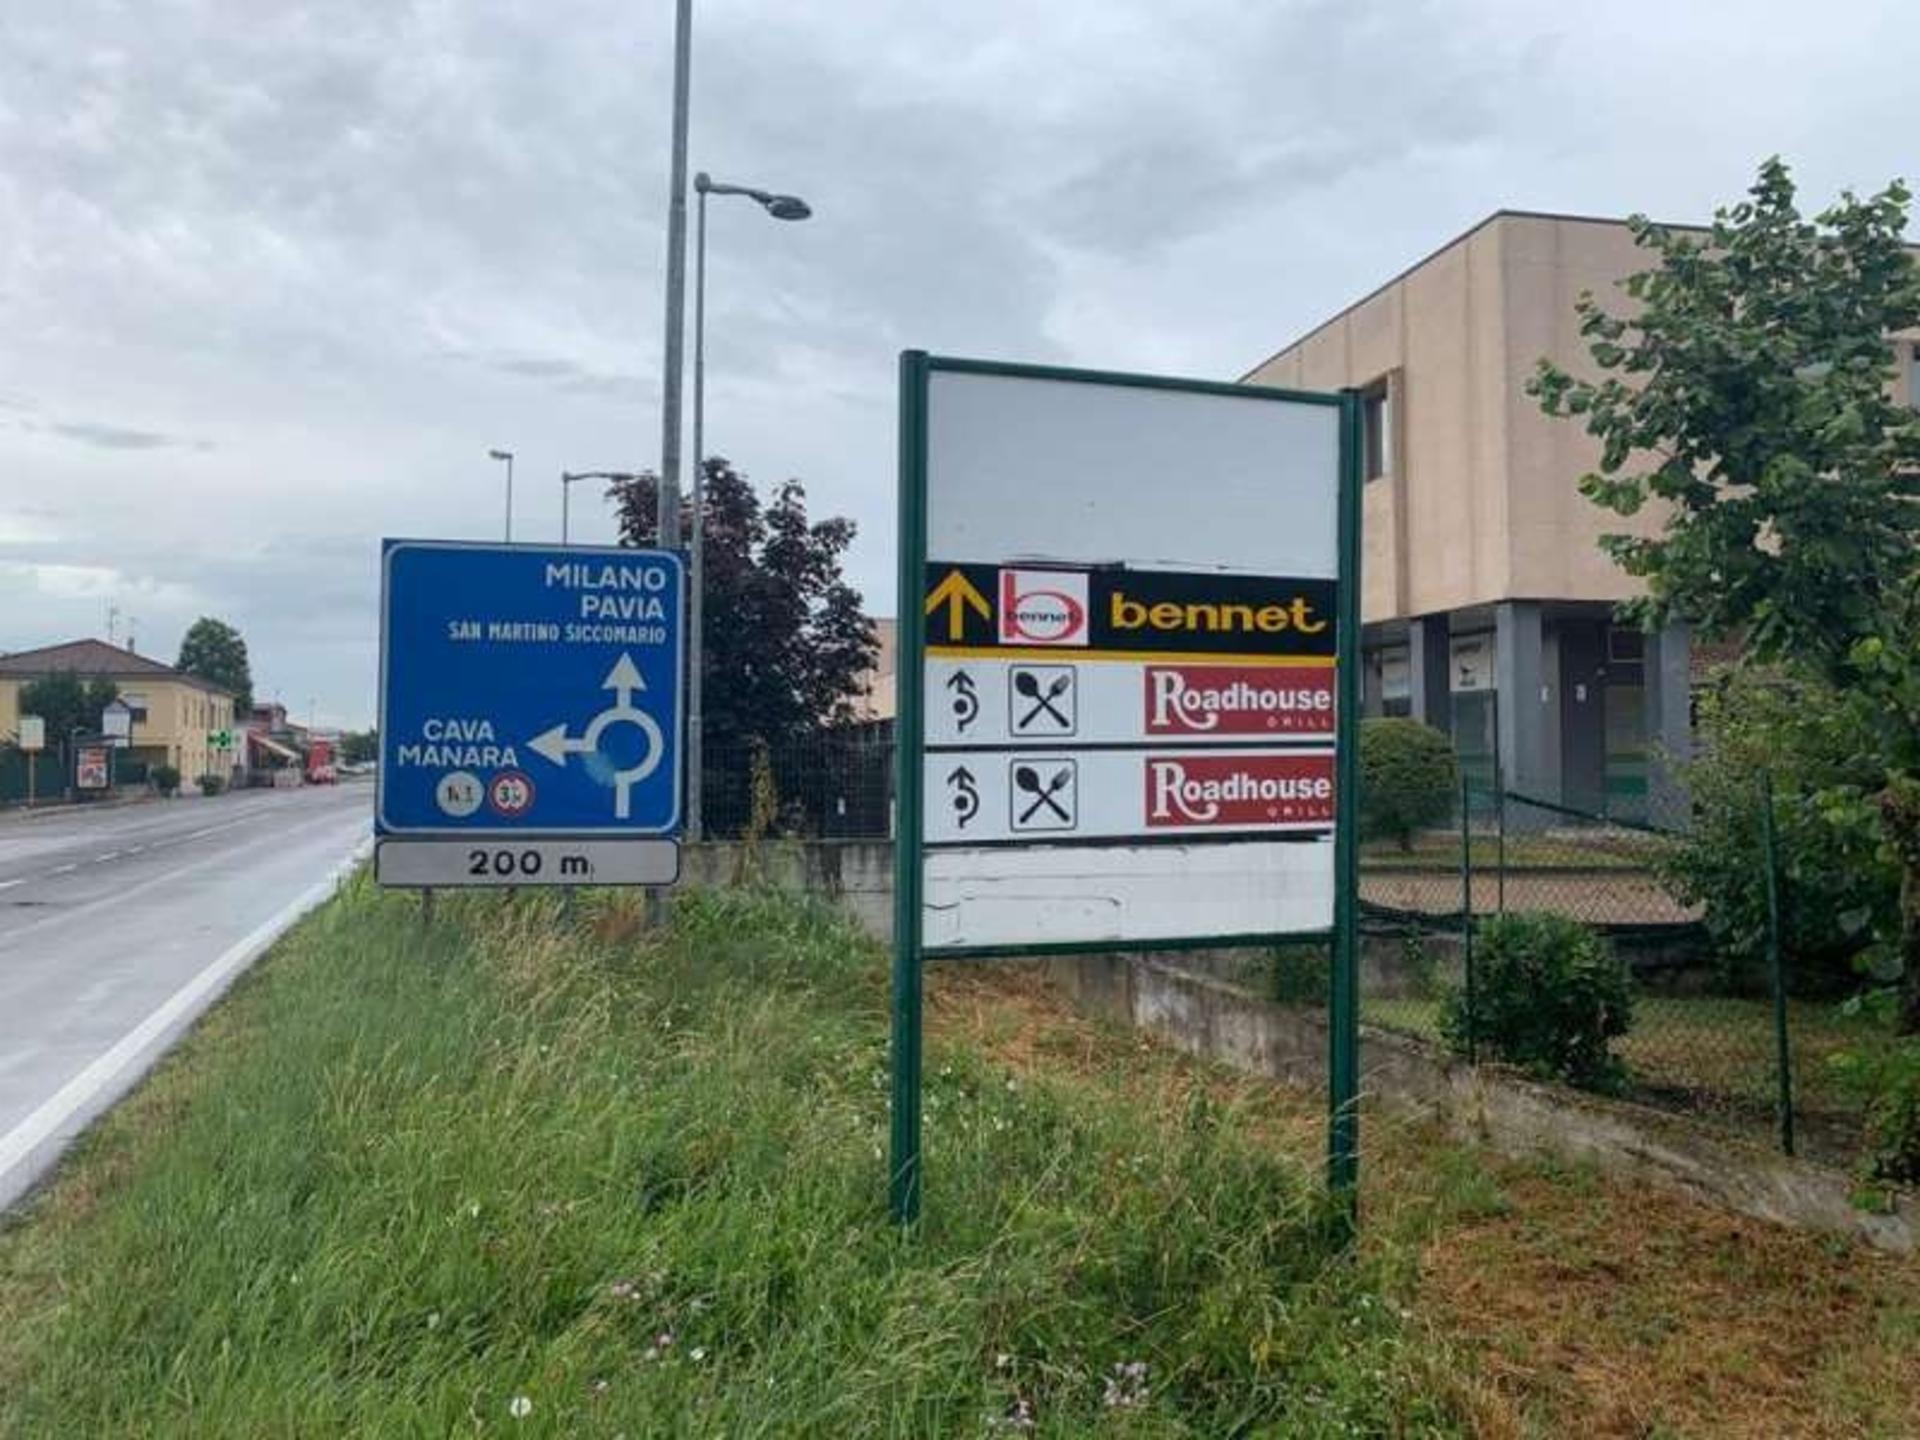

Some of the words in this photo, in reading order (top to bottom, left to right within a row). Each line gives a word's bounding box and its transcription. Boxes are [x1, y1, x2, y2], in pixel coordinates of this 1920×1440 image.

[545, 563, 667, 592] MILANO
[580, 594, 666, 620] PAVIA
[1111, 591, 1328, 633] bennet
[448, 621, 481, 641] SAN
[488, 622, 561, 643] MARTINO
[564, 624, 667, 645] SICCOMARIO
[1152, 670, 1332, 730] Roadhouse
[422, 718, 496, 743] CAVA
[1265, 715, 1331, 729] GRILL
[397, 743, 520, 768] MANARA
[1152, 761, 1332, 821] Roadhouse
[1266, 806, 1331, 818] GRILL
[468, 850, 542, 876] 200
[560, 855, 589, 876] m
